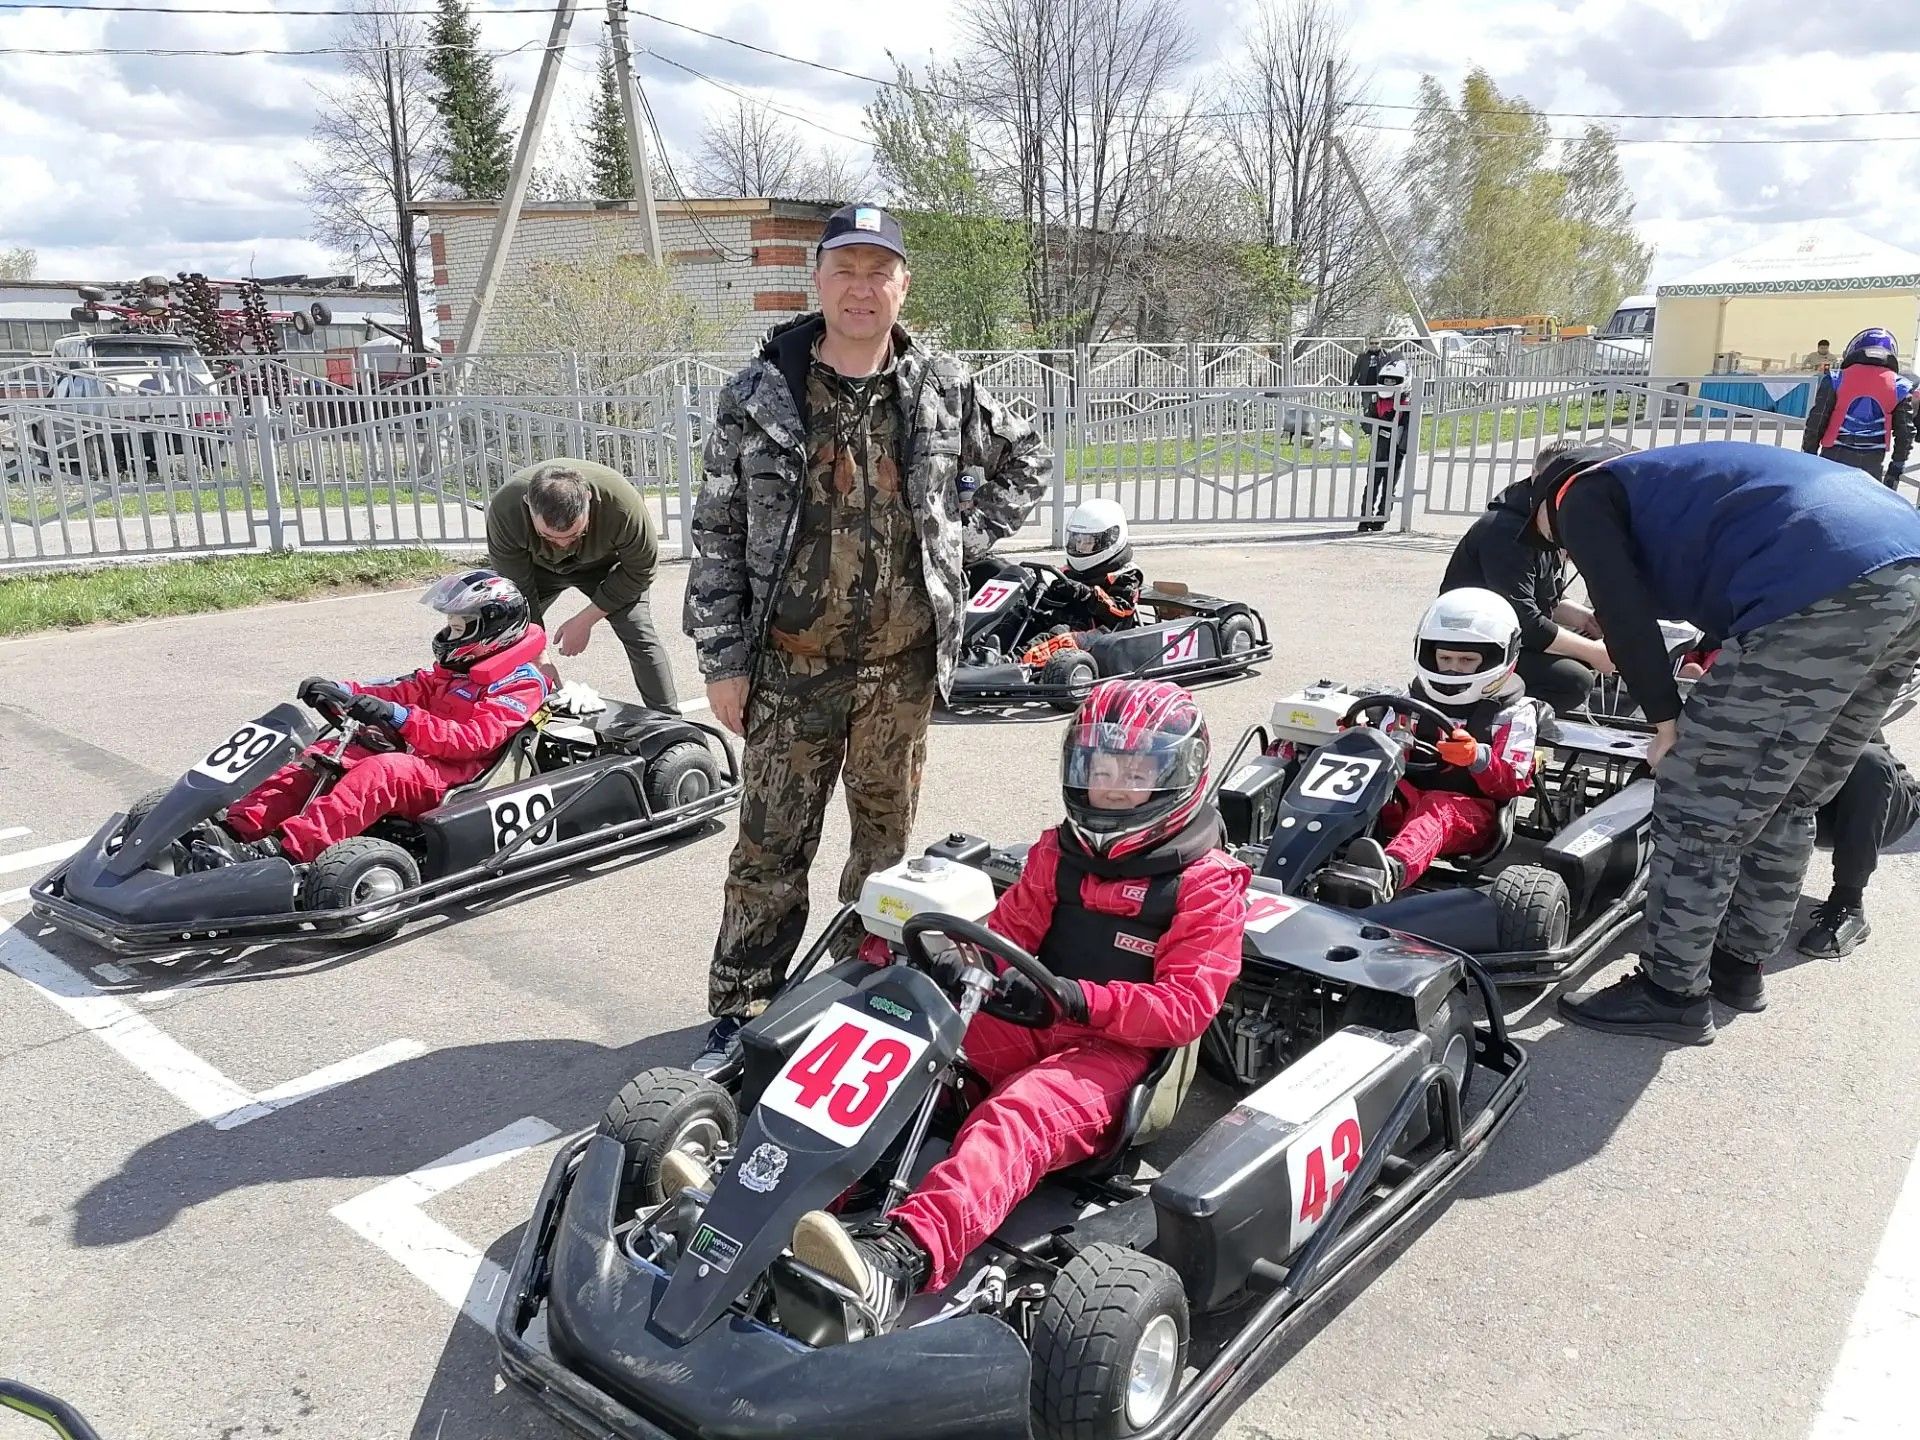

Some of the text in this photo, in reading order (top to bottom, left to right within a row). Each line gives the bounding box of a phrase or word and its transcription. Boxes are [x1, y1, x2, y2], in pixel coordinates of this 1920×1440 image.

[974, 586, 1009, 608] 57
[1167, 629, 1196, 660] 57
[206, 727, 277, 774] 89
[1308, 758, 1370, 796] 73
[495, 793, 555, 850] 89
[1120, 937, 1155, 953] RLG
[785, 1022, 912, 1128] 43
[1299, 1118, 1361, 1224] 43
